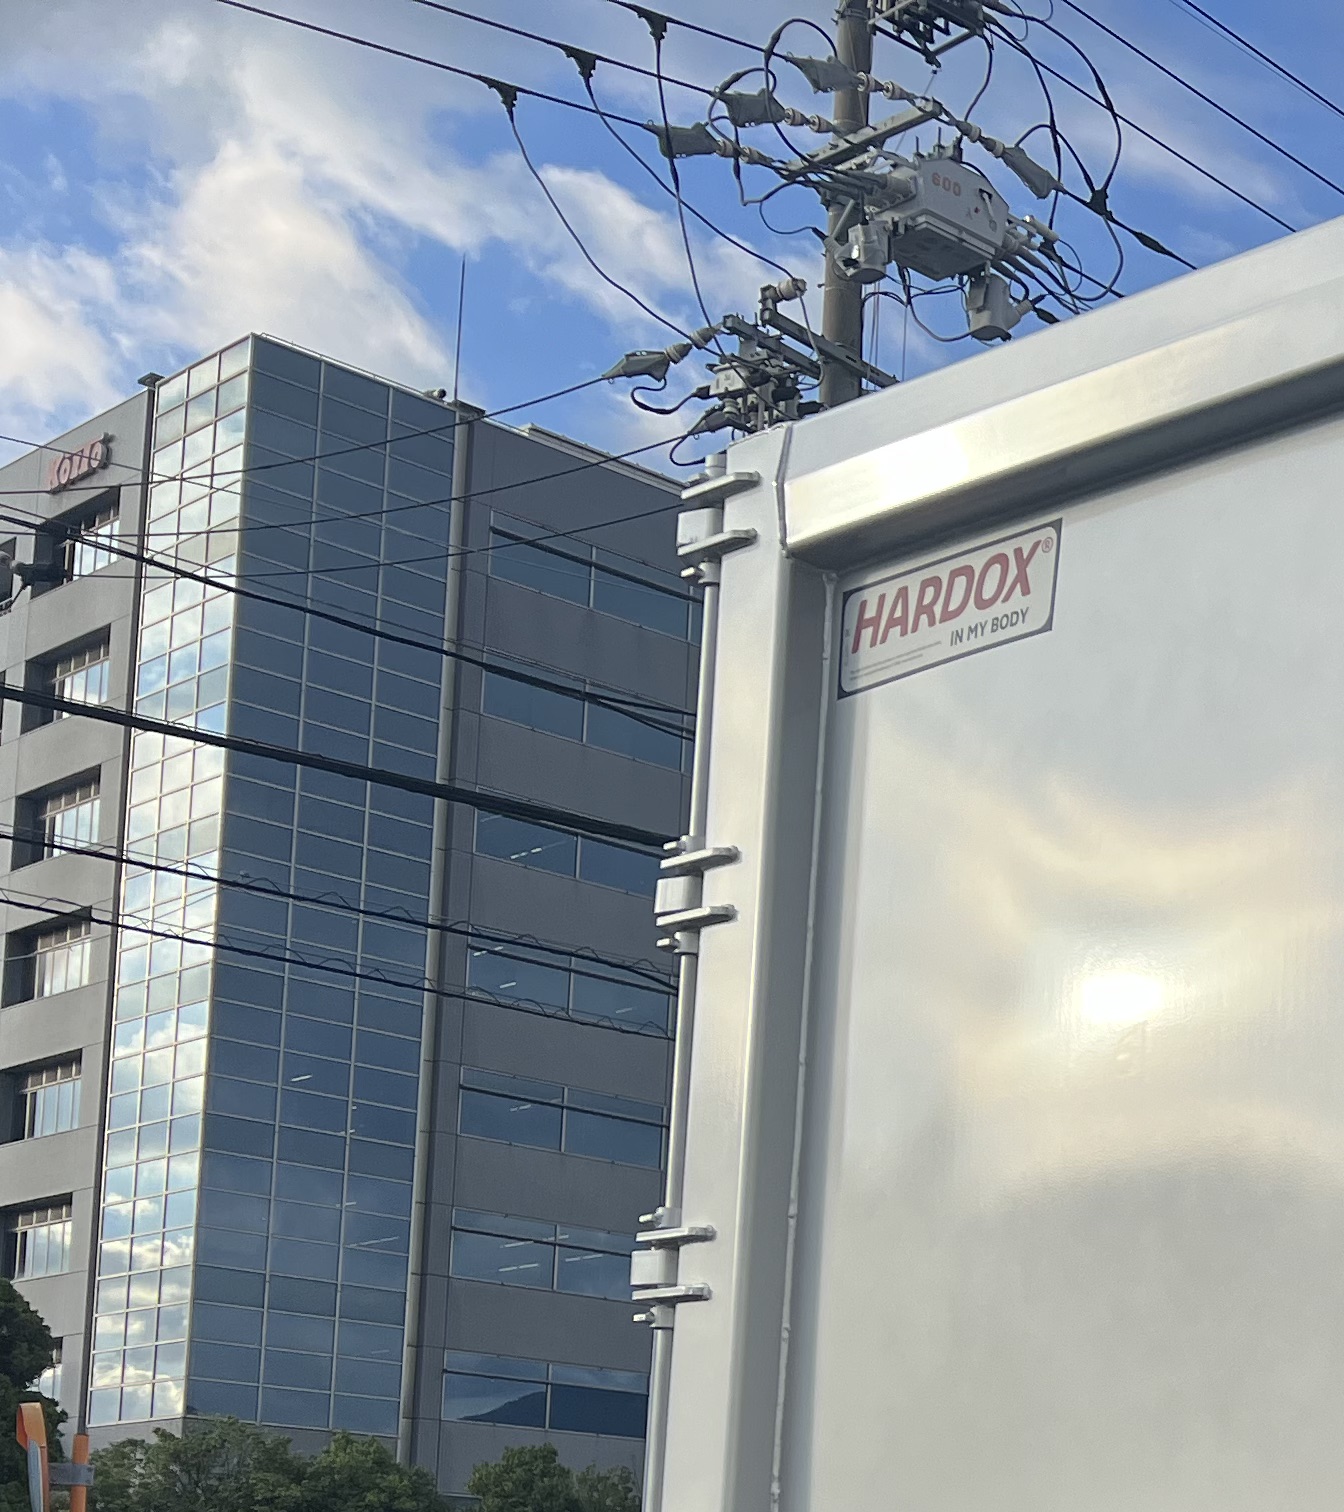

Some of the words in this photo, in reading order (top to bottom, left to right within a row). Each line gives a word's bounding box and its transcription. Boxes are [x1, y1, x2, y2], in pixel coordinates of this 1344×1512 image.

[950, 628, 964, 647] IN
[966, 620, 988, 642] MY
[990, 606, 1030, 634] BODY
